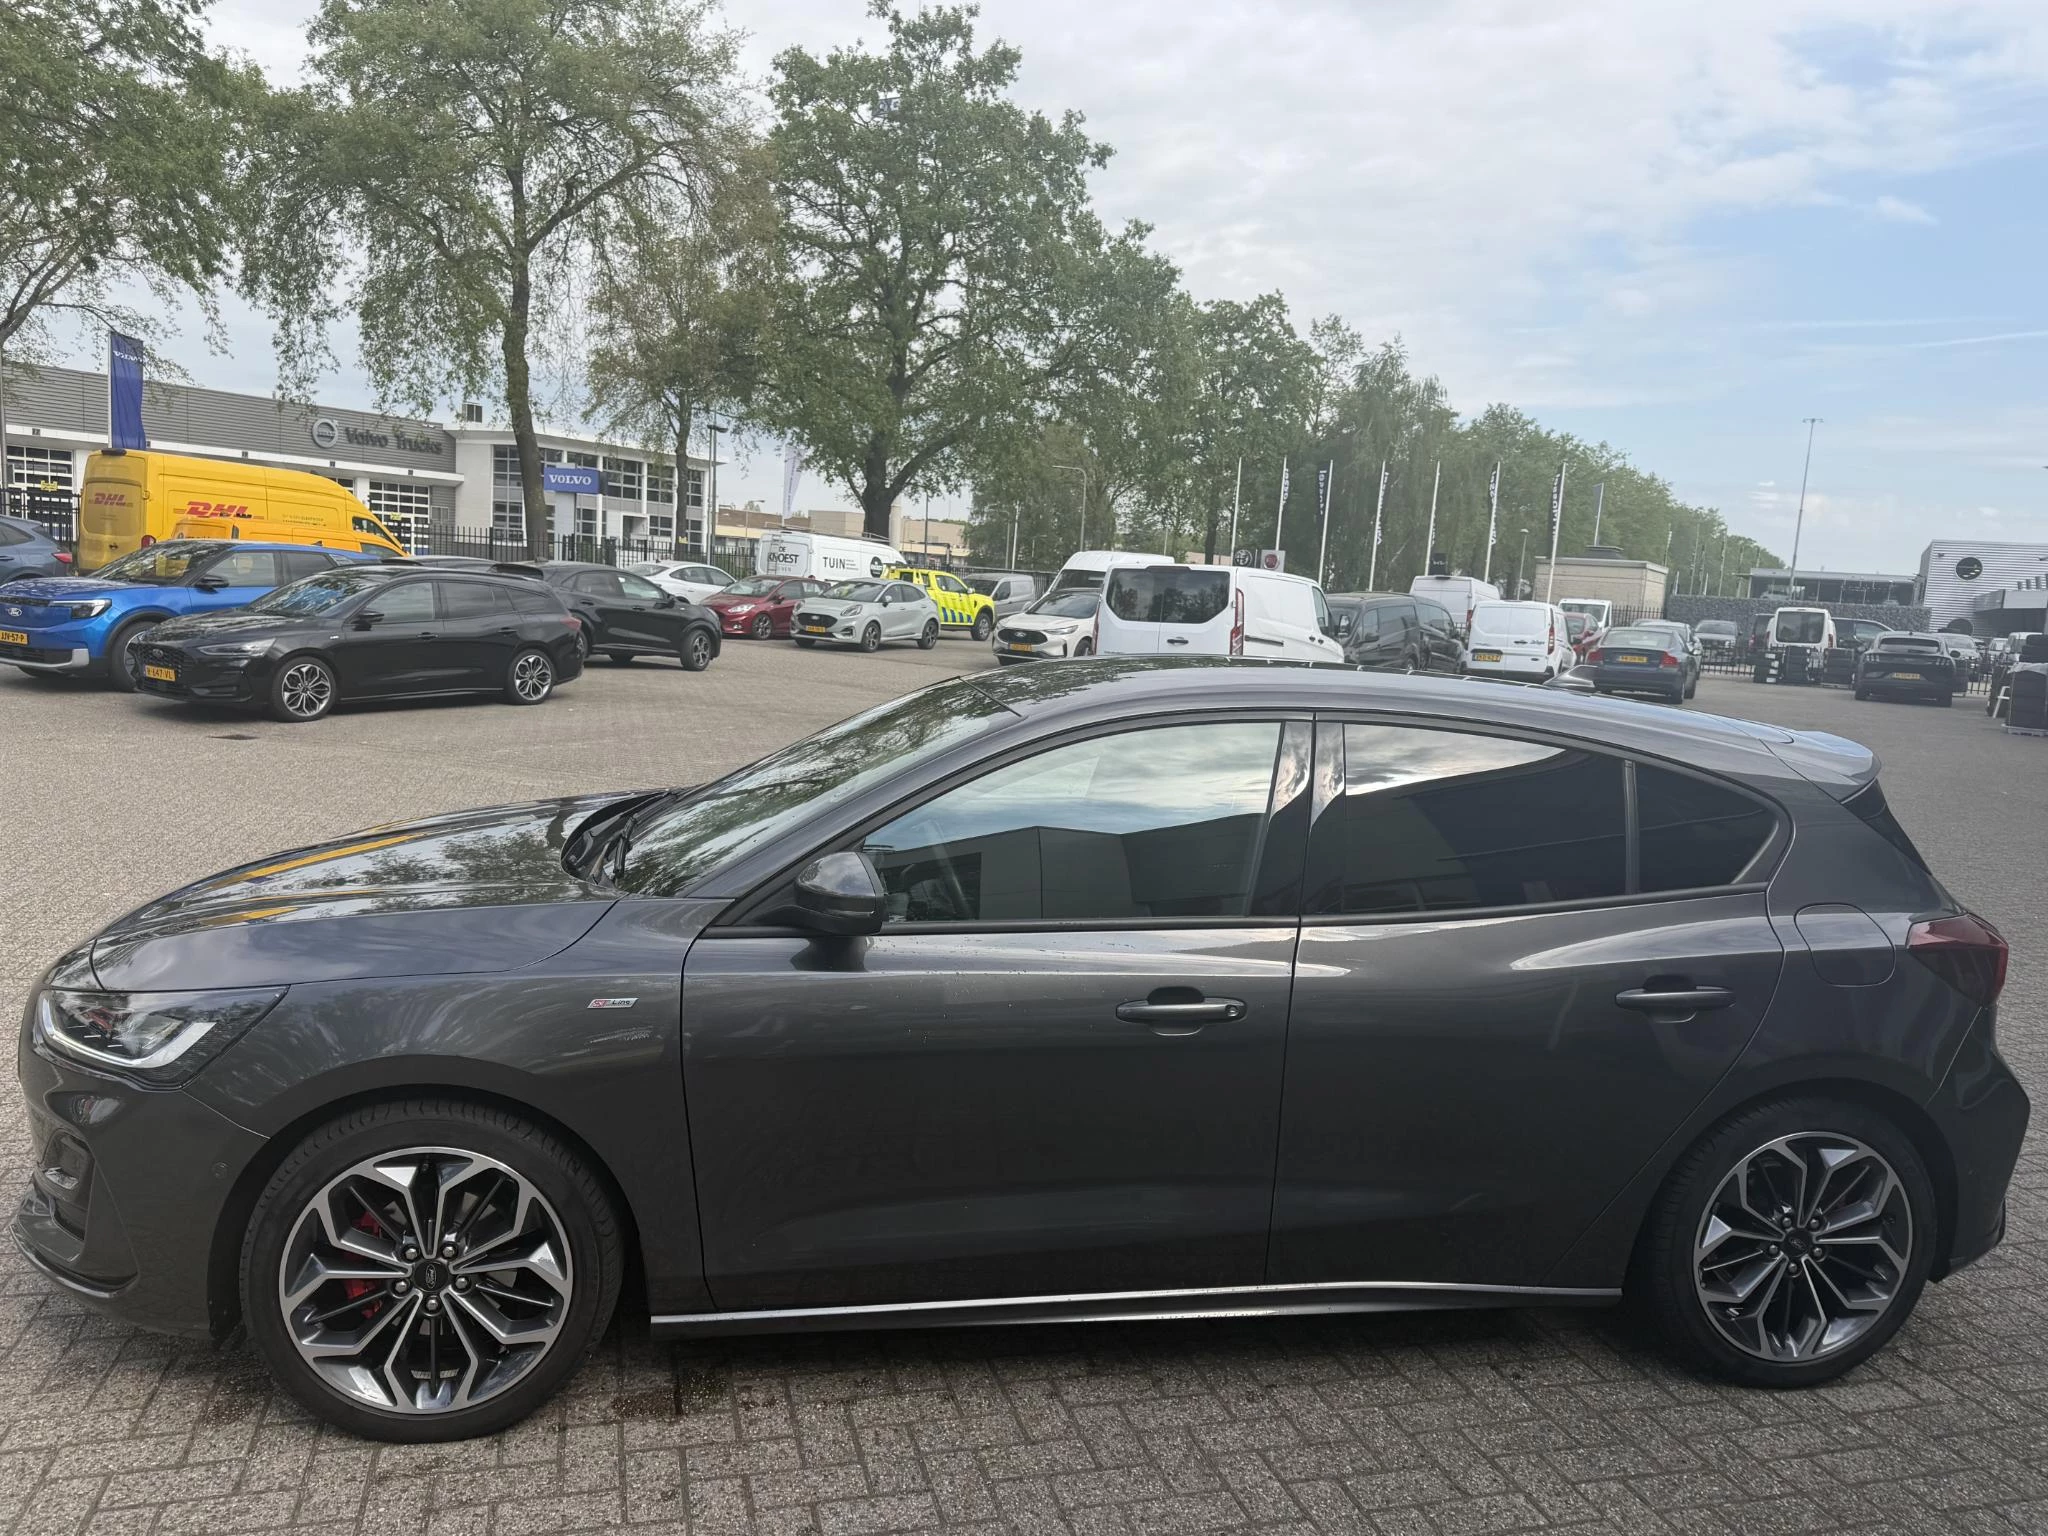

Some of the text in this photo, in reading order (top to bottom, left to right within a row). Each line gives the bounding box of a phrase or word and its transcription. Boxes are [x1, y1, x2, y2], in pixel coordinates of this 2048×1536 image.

[345, 427, 388, 448] Volvo
[548, 474, 592, 485] VOLVO
[93, 493, 127, 508] DHL
[186, 501, 250, 519] DHL
[823, 556, 846, 570] TUIN
